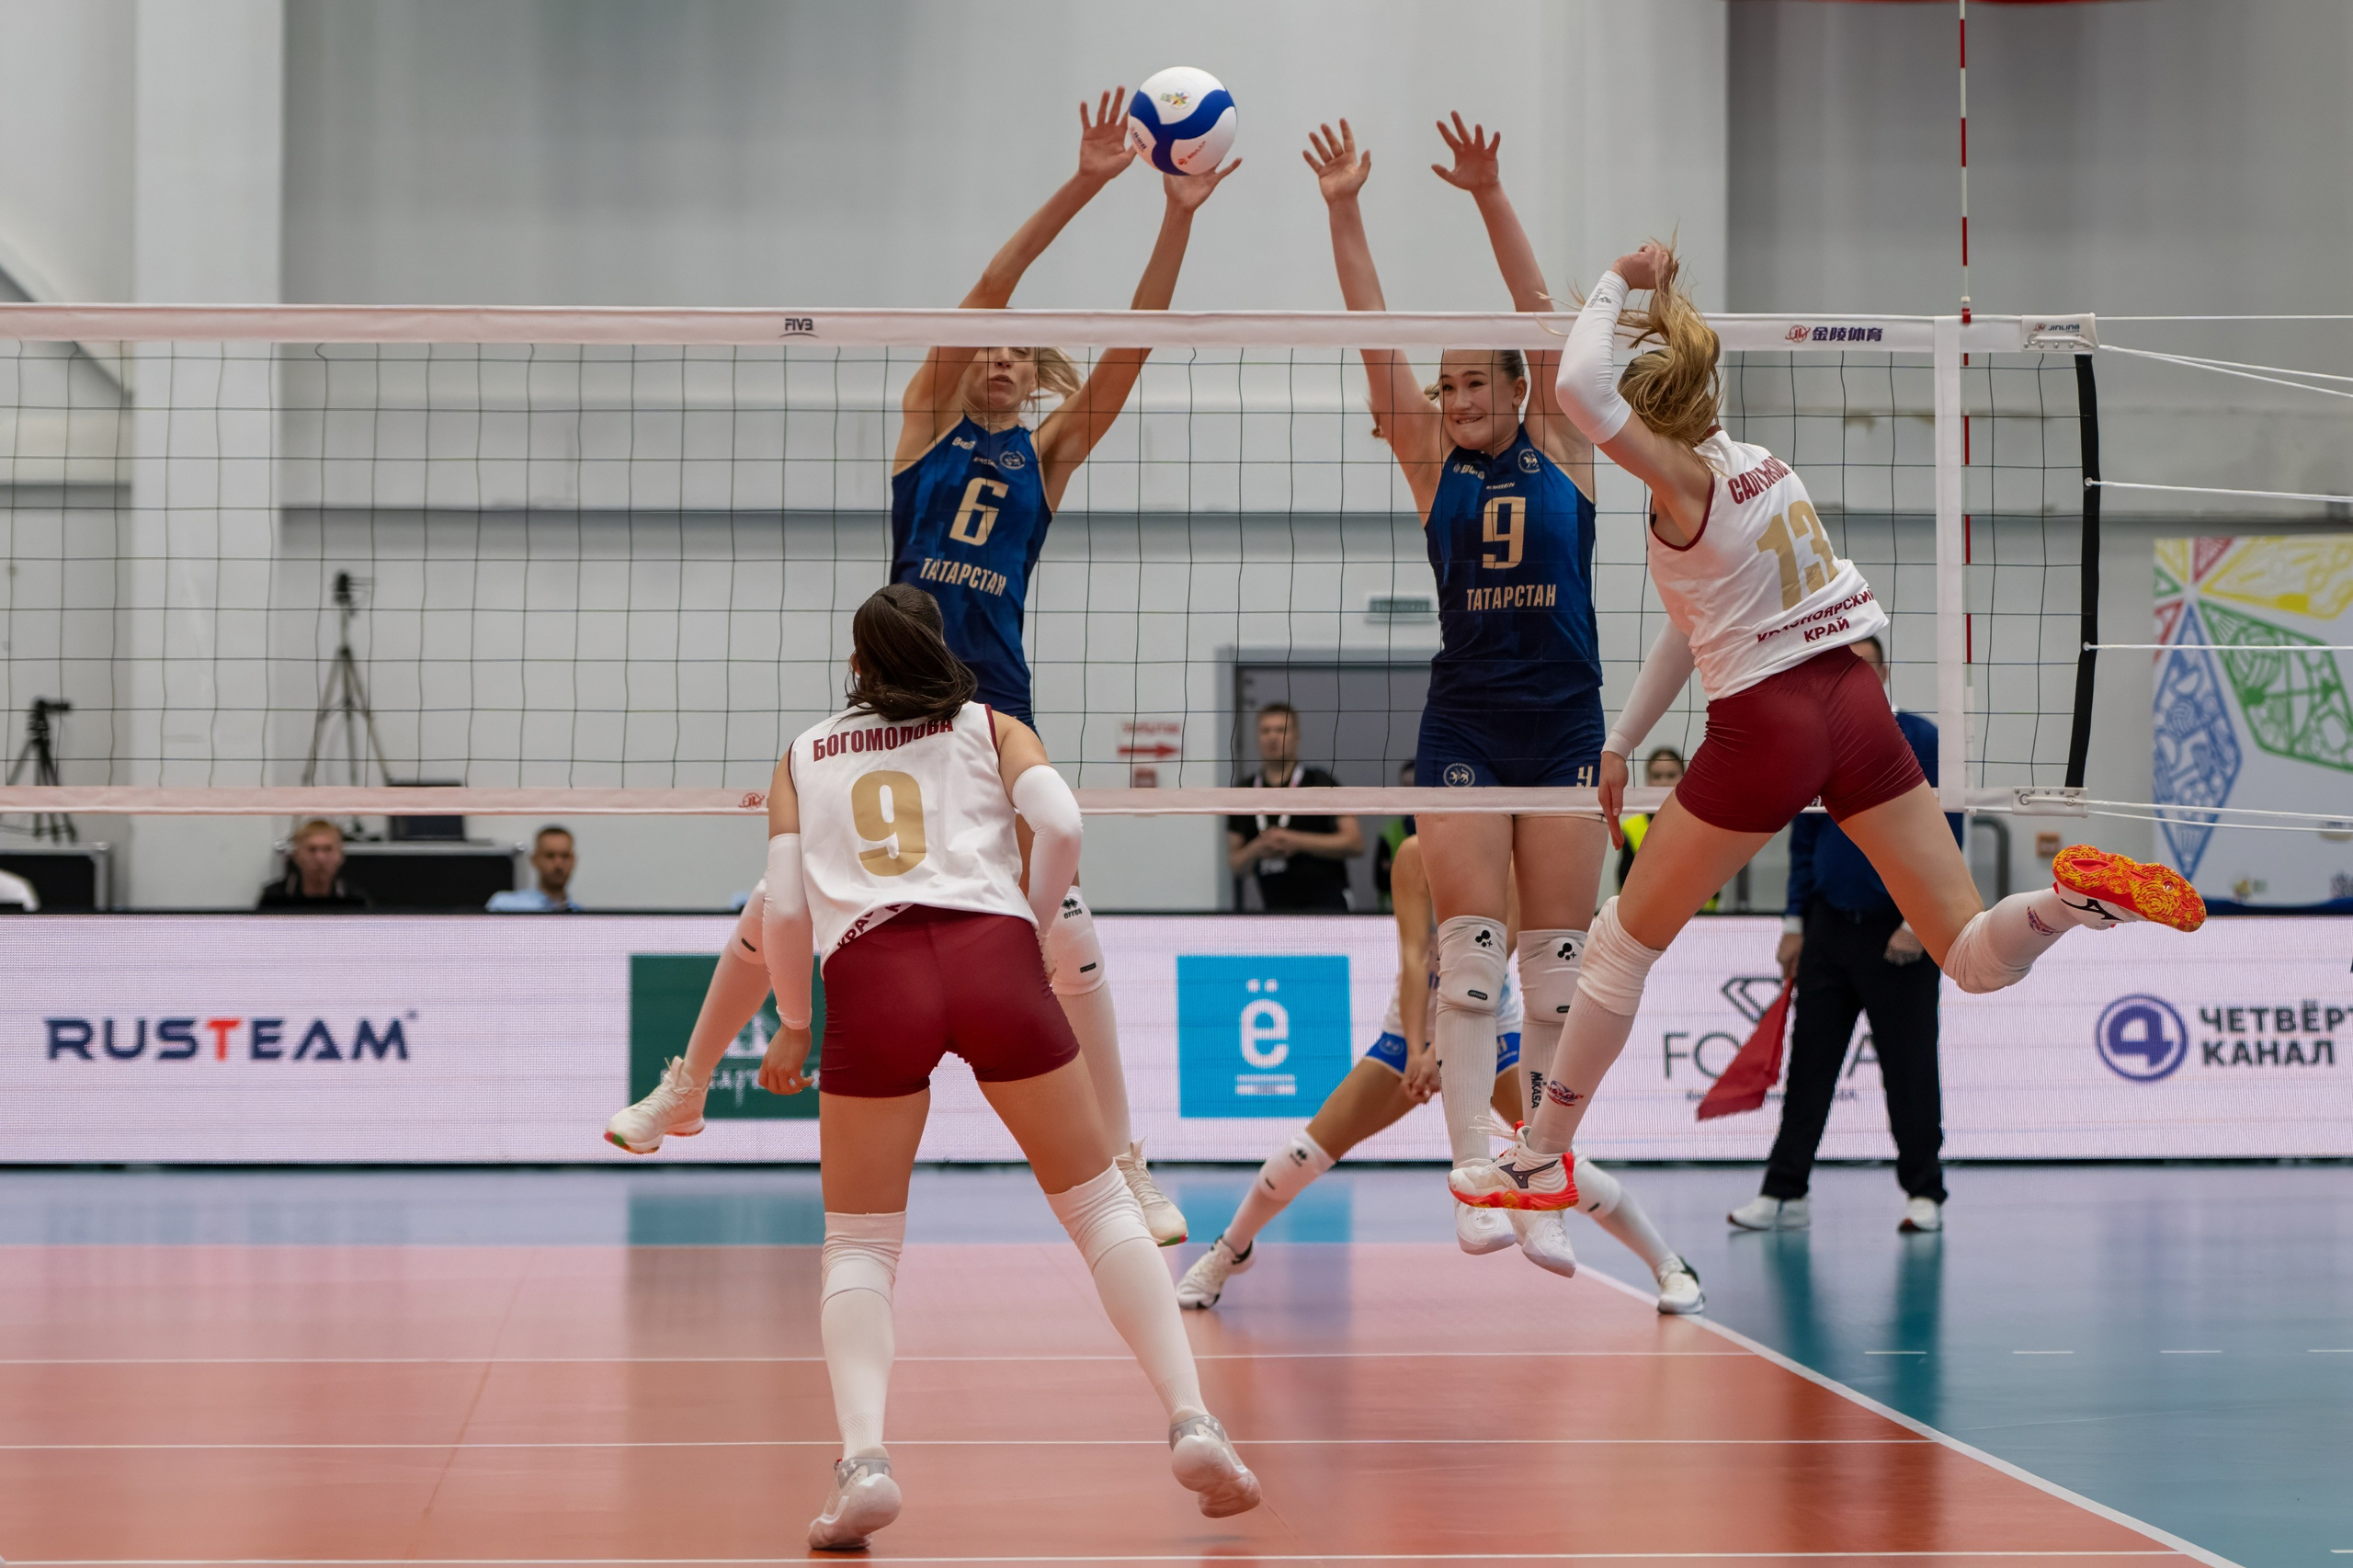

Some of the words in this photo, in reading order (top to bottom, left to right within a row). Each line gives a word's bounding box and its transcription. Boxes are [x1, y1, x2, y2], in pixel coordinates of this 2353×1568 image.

[1812, 326, 1883, 342] 金陵体育
[949, 477, 1009, 546] 6
[1482, 496, 1526, 569] 9
[1756, 500, 1839, 611] 13
[919, 557, 1007, 597] ТАТАРСТАН
[1466, 584, 1557, 611] ТАТАРСТАН
[1803, 617, 1850, 642] КРАЙ
[851, 770, 926, 877] 9
[44, 1017, 410, 1061] RUSTEAM
[2202, 1040, 2336, 1065] КАНАЛ
